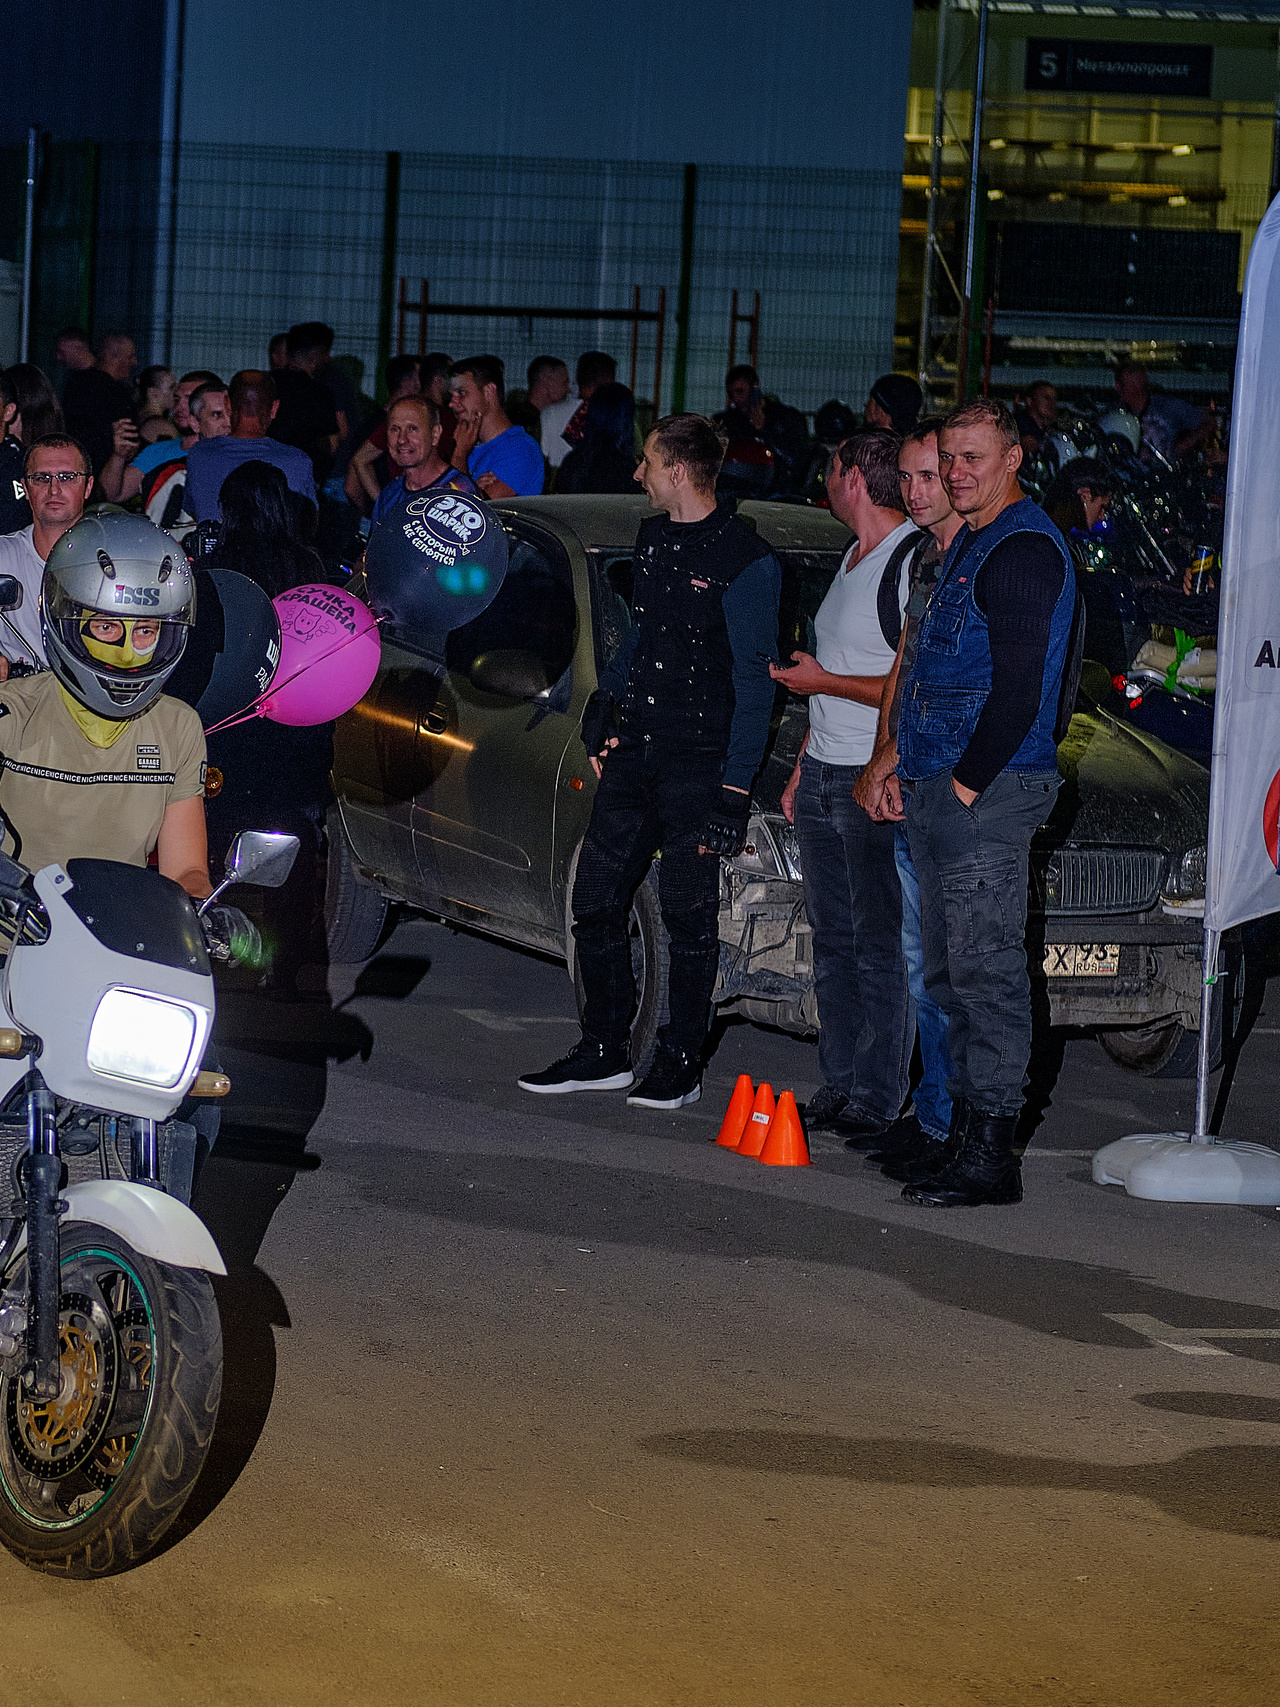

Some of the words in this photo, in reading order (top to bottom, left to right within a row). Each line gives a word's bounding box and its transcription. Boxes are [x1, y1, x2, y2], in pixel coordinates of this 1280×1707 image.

[1038, 51, 1059, 80] 5
[426, 507, 472, 543] ШАРИК
[433, 496, 483, 530] ЭТО
[402, 523, 416, 539] ВСЕ
[413, 525, 457, 557] КОТОРЫМ
[277, 593, 357, 636] КРАШЕНА
[296, 586, 356, 618] СУЧКА
[1076, 962, 1098, 974] RUS
